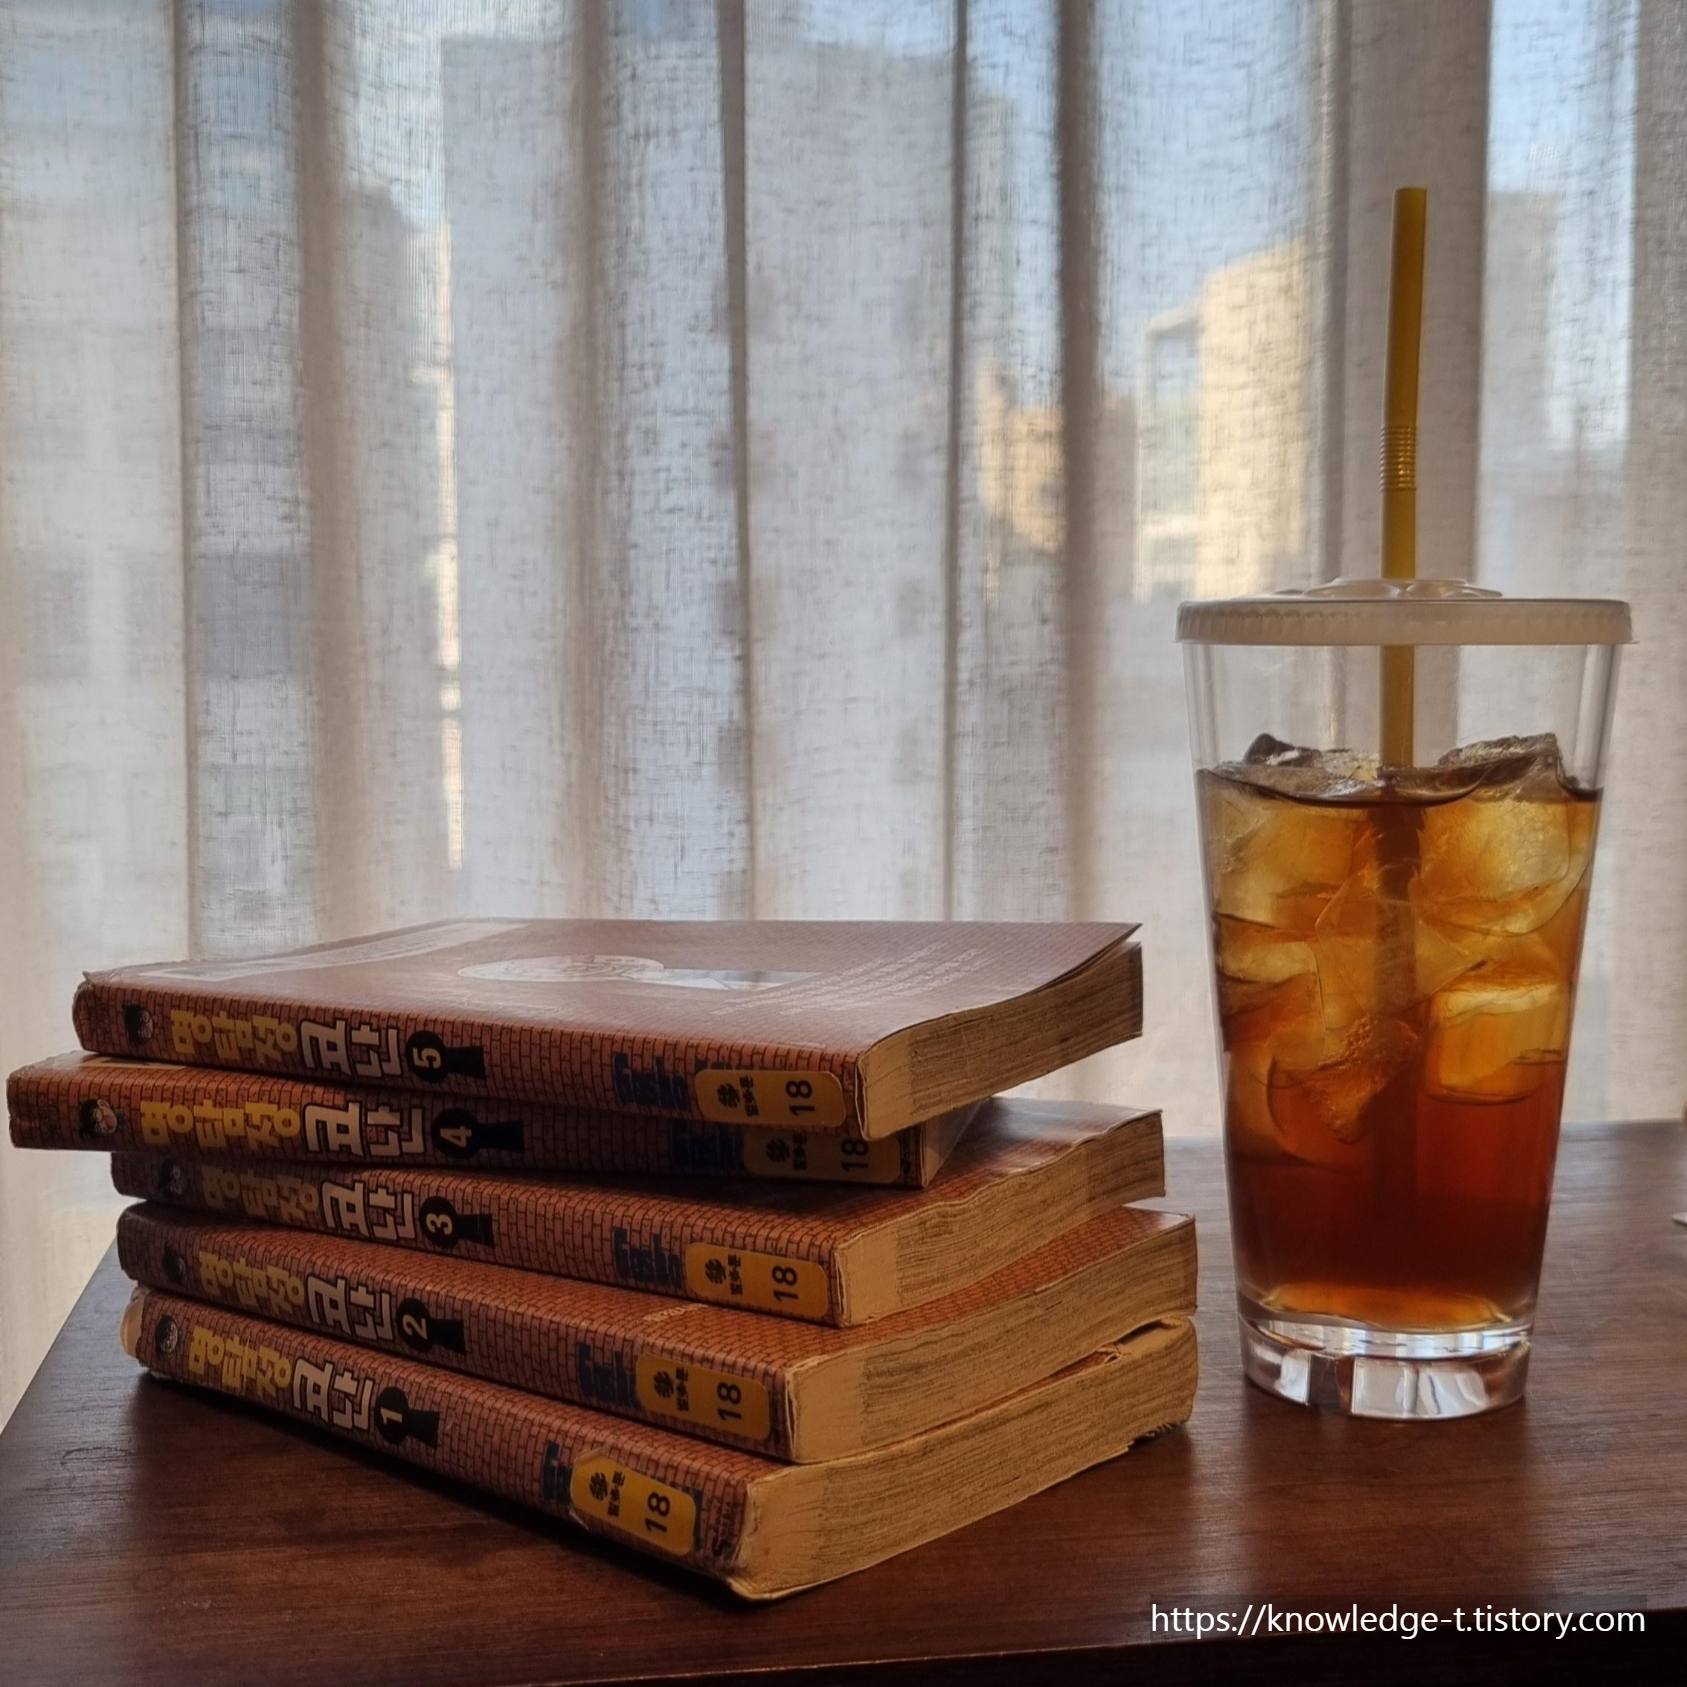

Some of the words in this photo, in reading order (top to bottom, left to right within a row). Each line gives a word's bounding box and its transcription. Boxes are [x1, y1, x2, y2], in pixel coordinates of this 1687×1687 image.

[170, 1009, 299, 1064] 명탐정
[300, 1018, 401, 1079] 코난
[412, 1047, 442, 1070] 5
[785, 1078, 817, 1117] 18
[140, 1099, 301, 1150] 명탐정
[303, 1101, 425, 1158] 코난
[439, 1124, 473, 1149] 4
[840, 1138, 870, 1172] 18
[200, 1164, 319, 1226] 명탐정
[321, 1180, 416, 1241] 코난
[425, 1212, 454, 1237] 3
[198, 1250, 305, 1315] 명탐정
[306, 1273, 394, 1341] 코난
[402, 1313, 428, 1340] 2
[771, 1265, 799, 1302] 18
[187, 1325, 292, 1398] 명탐정
[292, 1356, 375, 1431] 코난
[379, 1406, 404, 1426] 1
[716, 1382, 743, 1422] 18
[644, 1491, 671, 1534] 18
